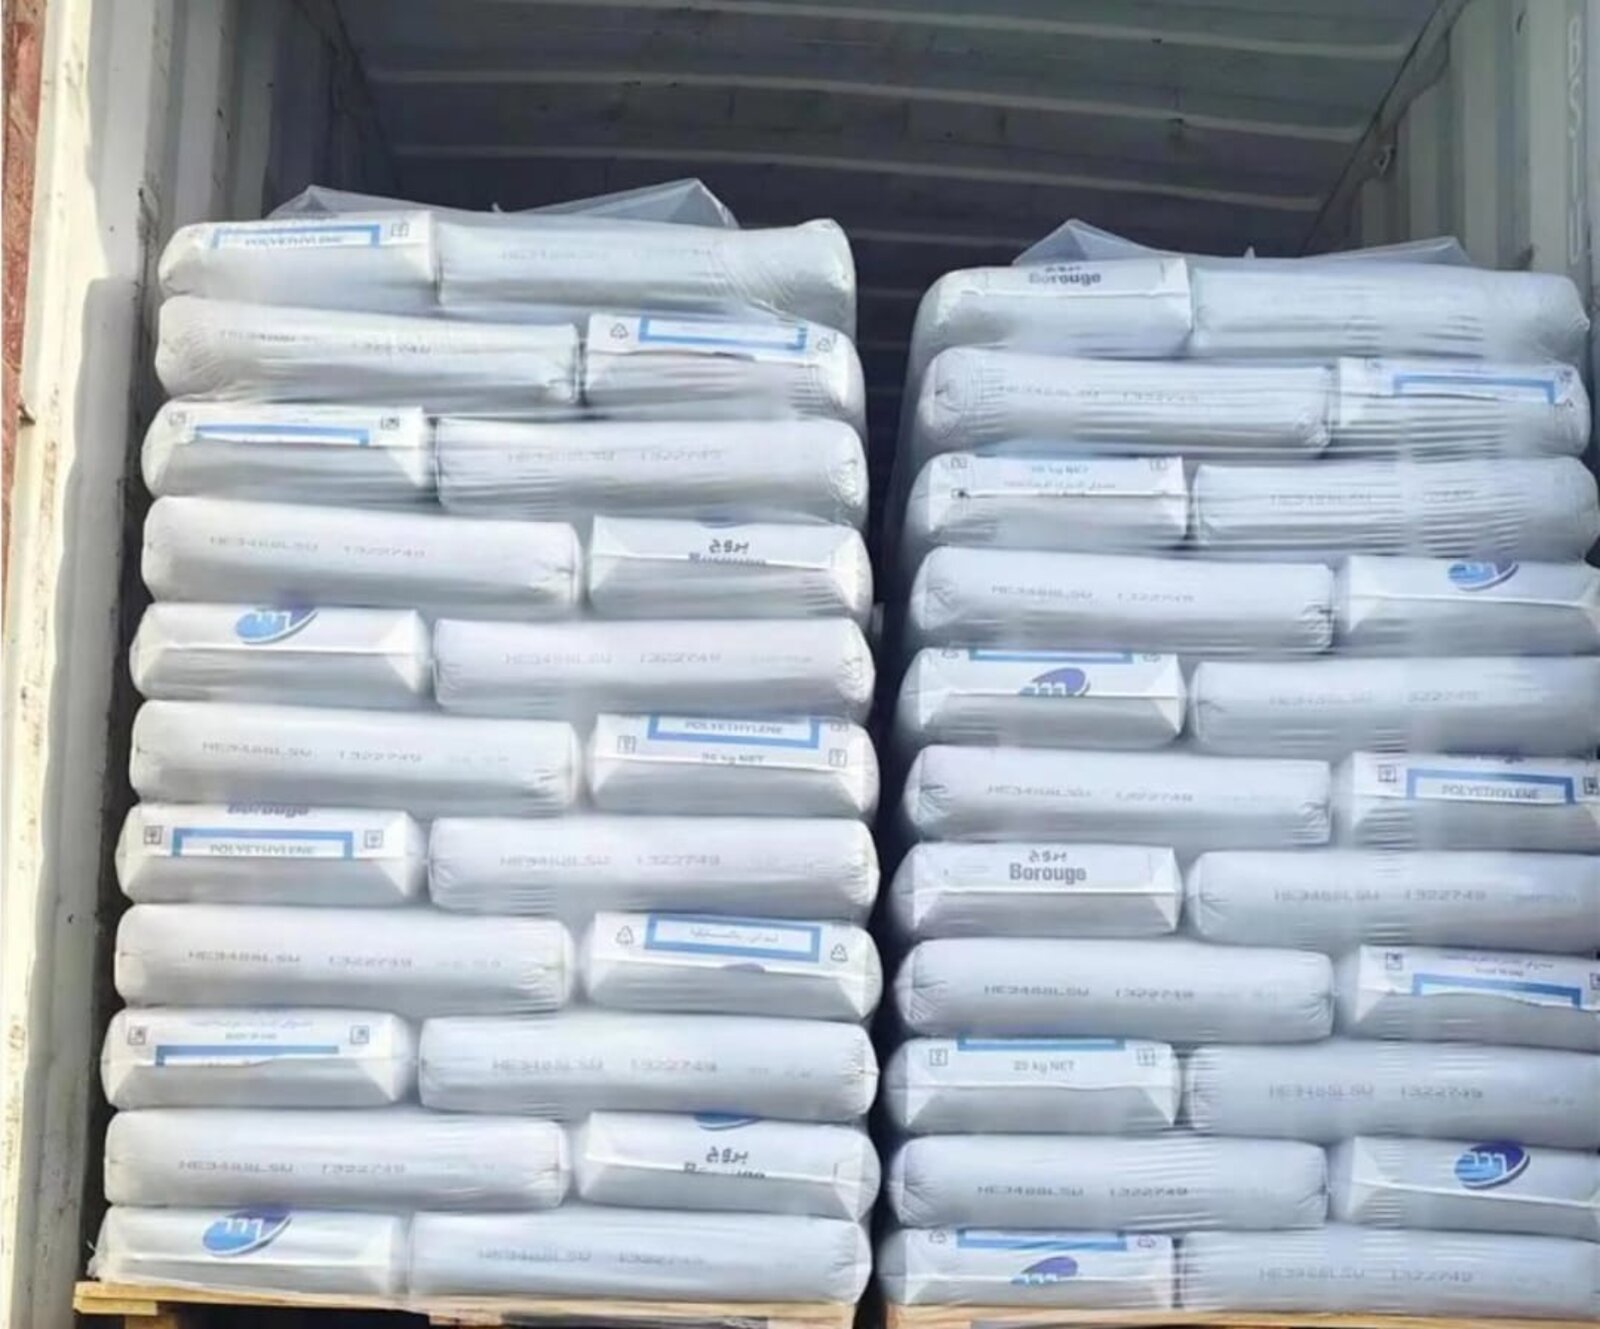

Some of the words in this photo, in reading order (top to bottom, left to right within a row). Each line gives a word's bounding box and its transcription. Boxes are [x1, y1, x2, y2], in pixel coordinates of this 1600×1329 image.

[1029, 267, 1102, 287] Borouge
[1009, 862, 1087, 885] Borouge
[1049, 1060, 1076, 1072] NET
[705, 1146, 749, 1165] بروج
